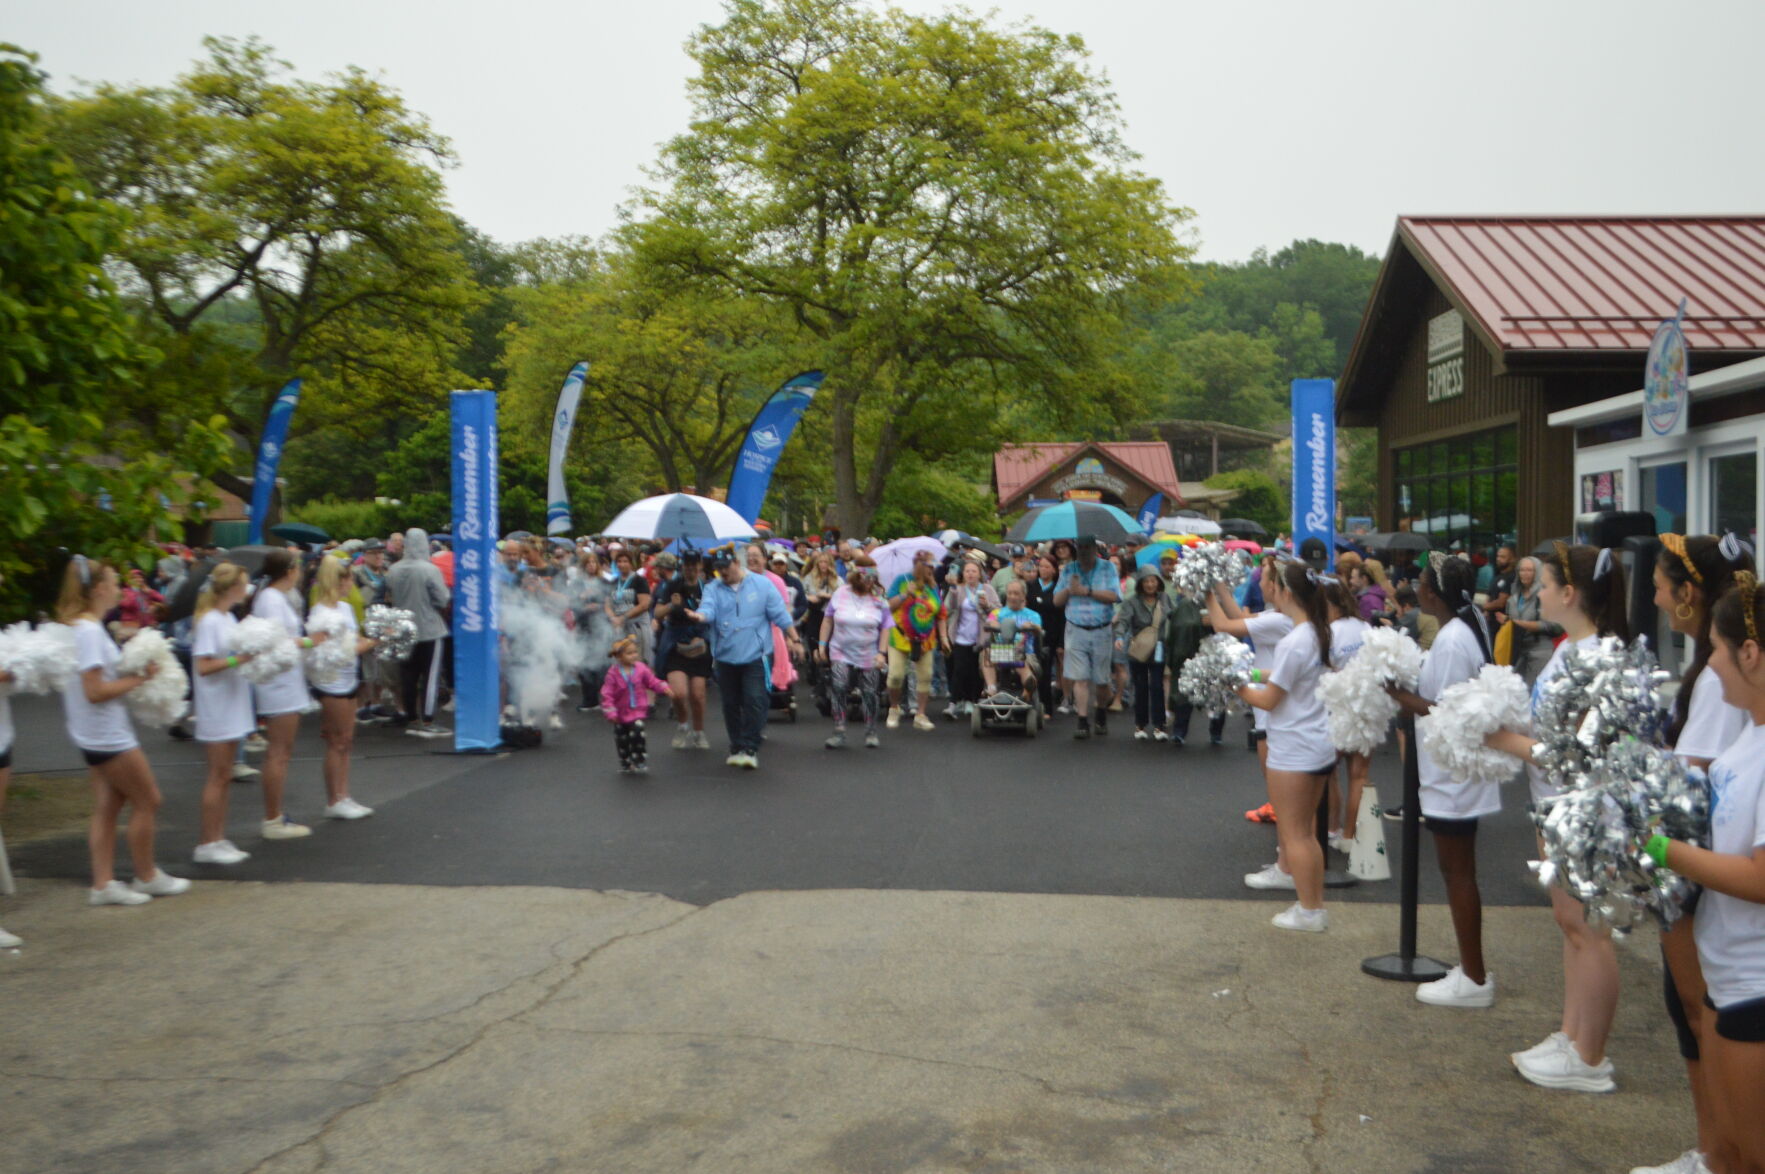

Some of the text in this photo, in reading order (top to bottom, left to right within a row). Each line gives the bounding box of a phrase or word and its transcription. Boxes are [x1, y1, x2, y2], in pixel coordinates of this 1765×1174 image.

[1427, 357, 1464, 403] EXPRESS
[459, 425, 482, 631] Walk to Remember
[1306, 413, 1328, 533] Remember
